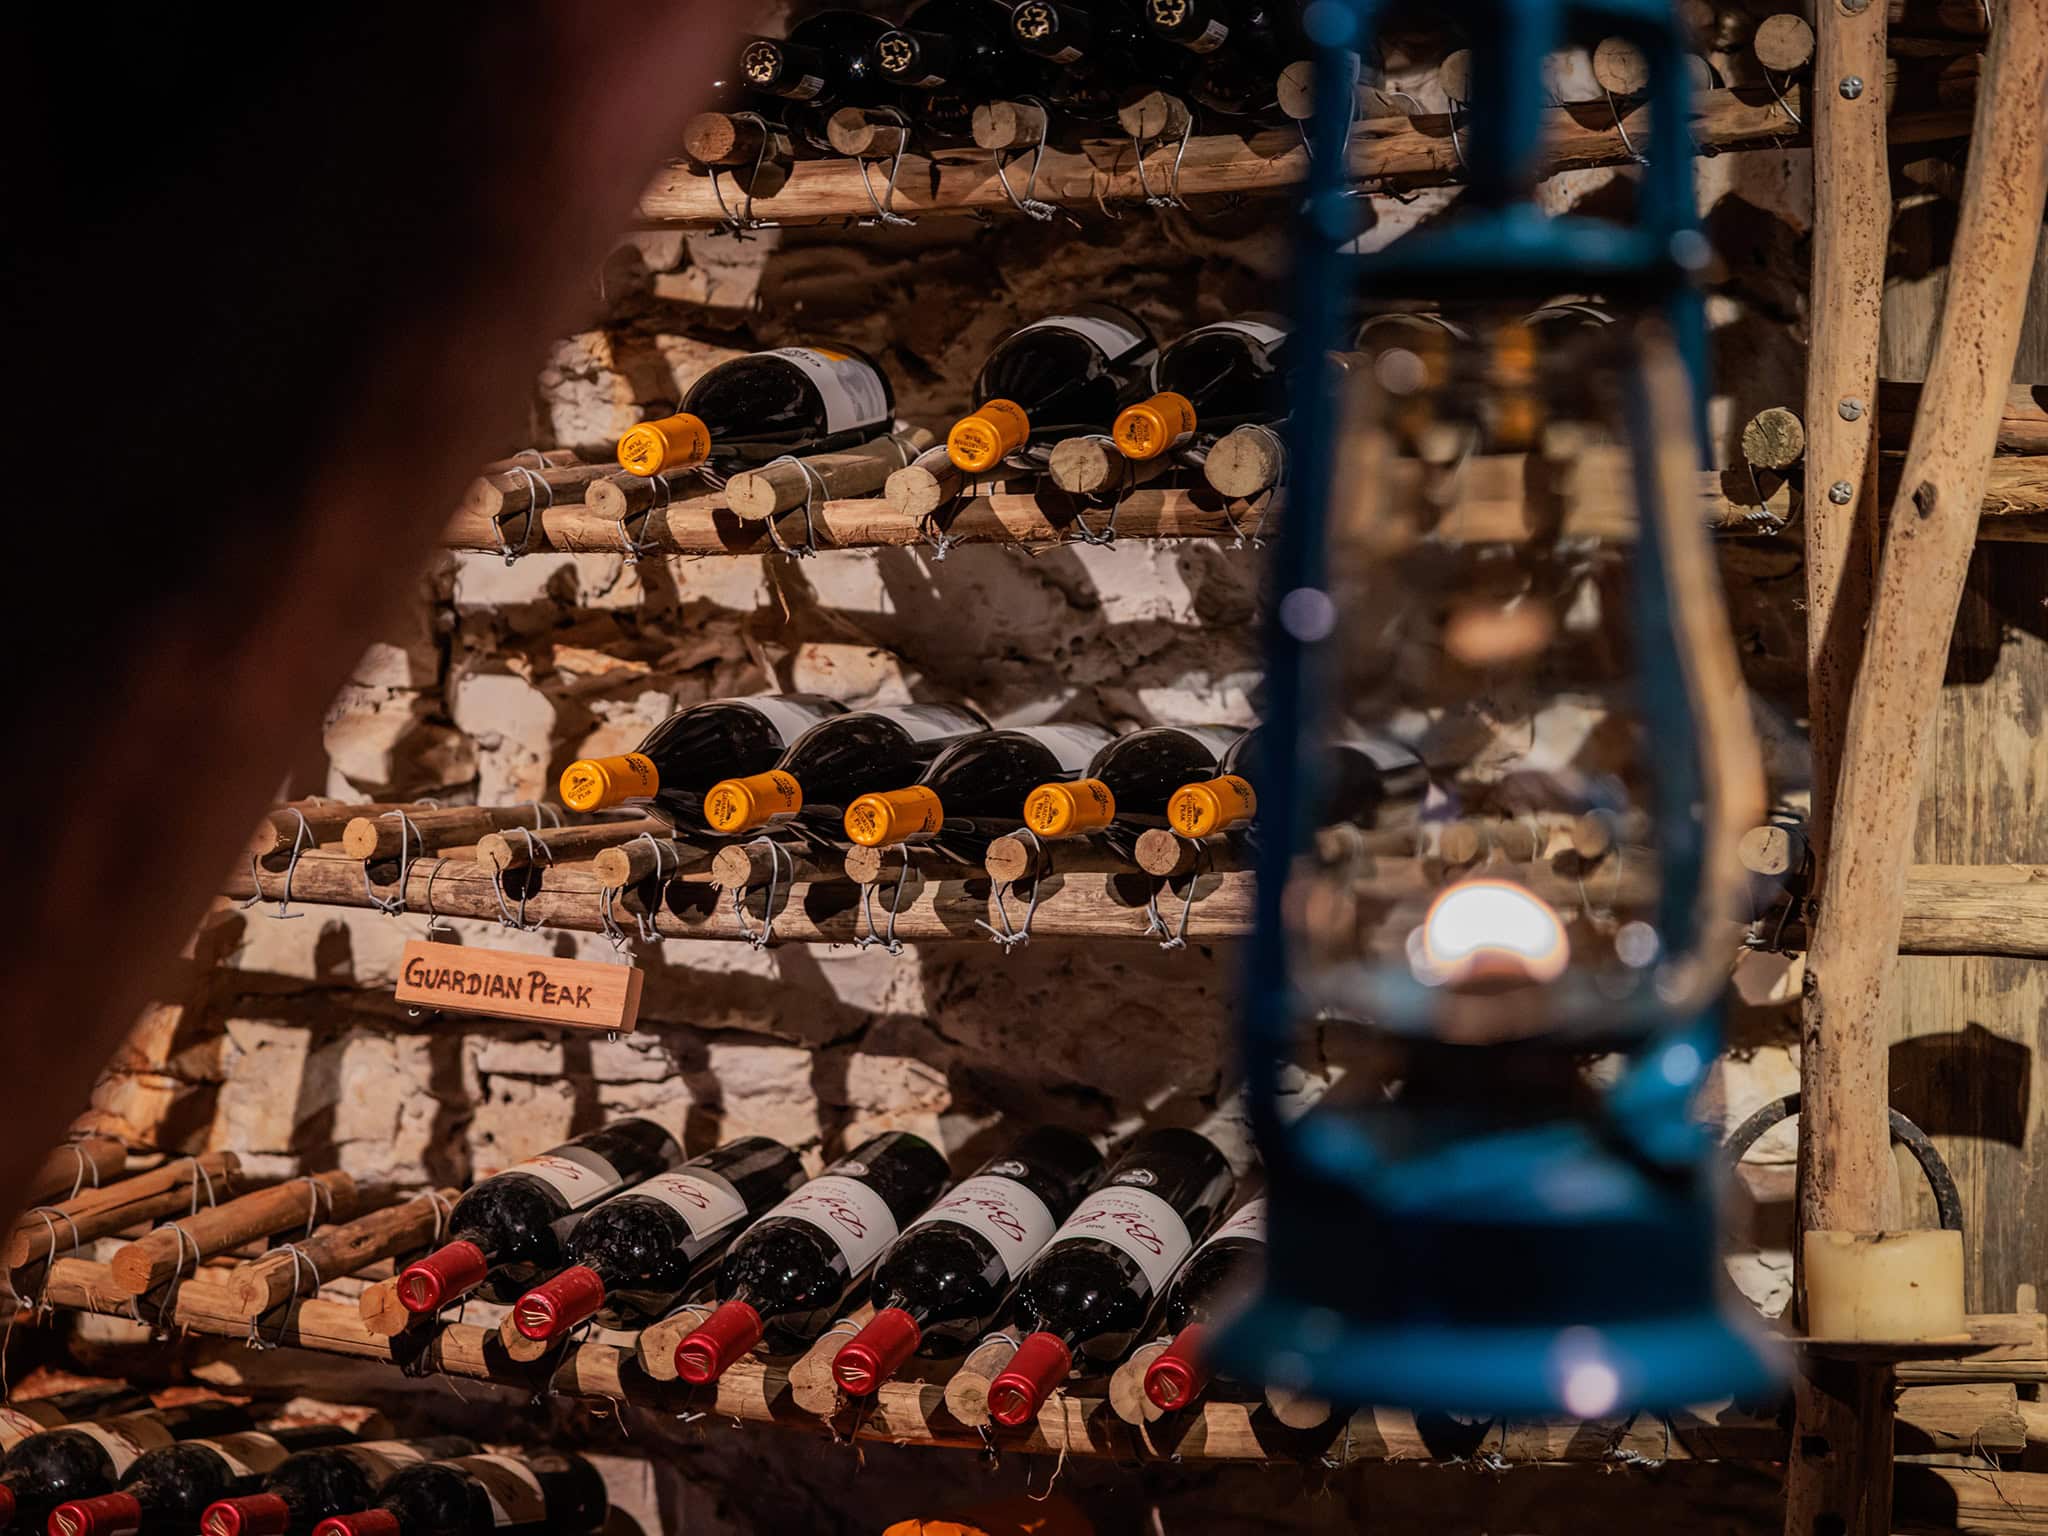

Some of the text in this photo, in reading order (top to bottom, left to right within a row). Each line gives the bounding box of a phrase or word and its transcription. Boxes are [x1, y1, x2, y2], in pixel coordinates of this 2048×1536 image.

[404, 957, 593, 1009] GUARDIAN PEAK
[1109, 1212, 1165, 1255] Big
